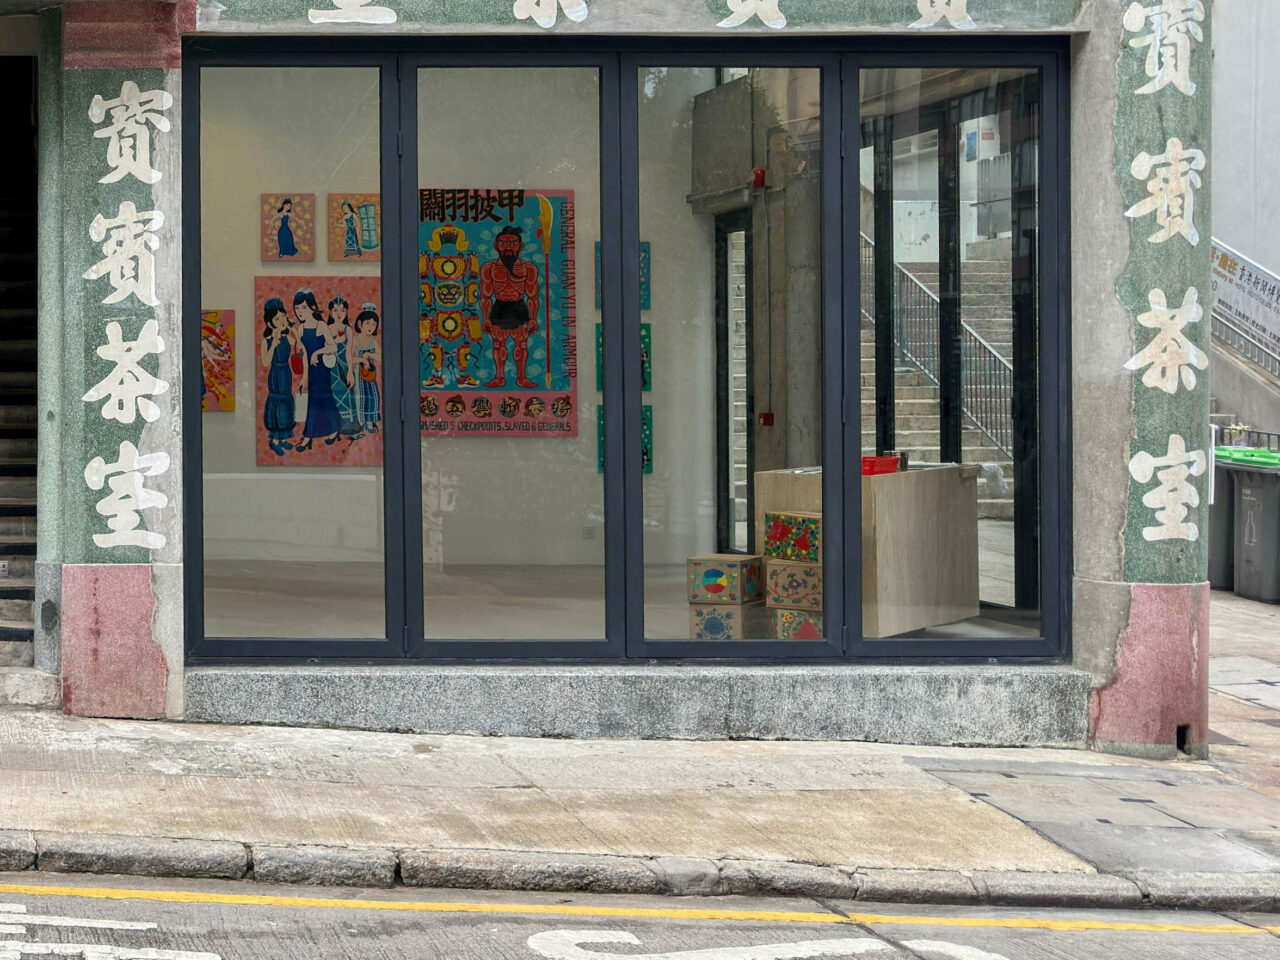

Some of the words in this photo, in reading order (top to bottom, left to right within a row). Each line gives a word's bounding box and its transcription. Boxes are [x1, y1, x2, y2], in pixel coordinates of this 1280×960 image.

[560, 201, 575, 254] GENERAL
[560, 259, 576, 290] GUAN
[561, 294, 576, 311] YU
[562, 316, 576, 328] IN
[562, 333, 577, 379] ARMOUR
